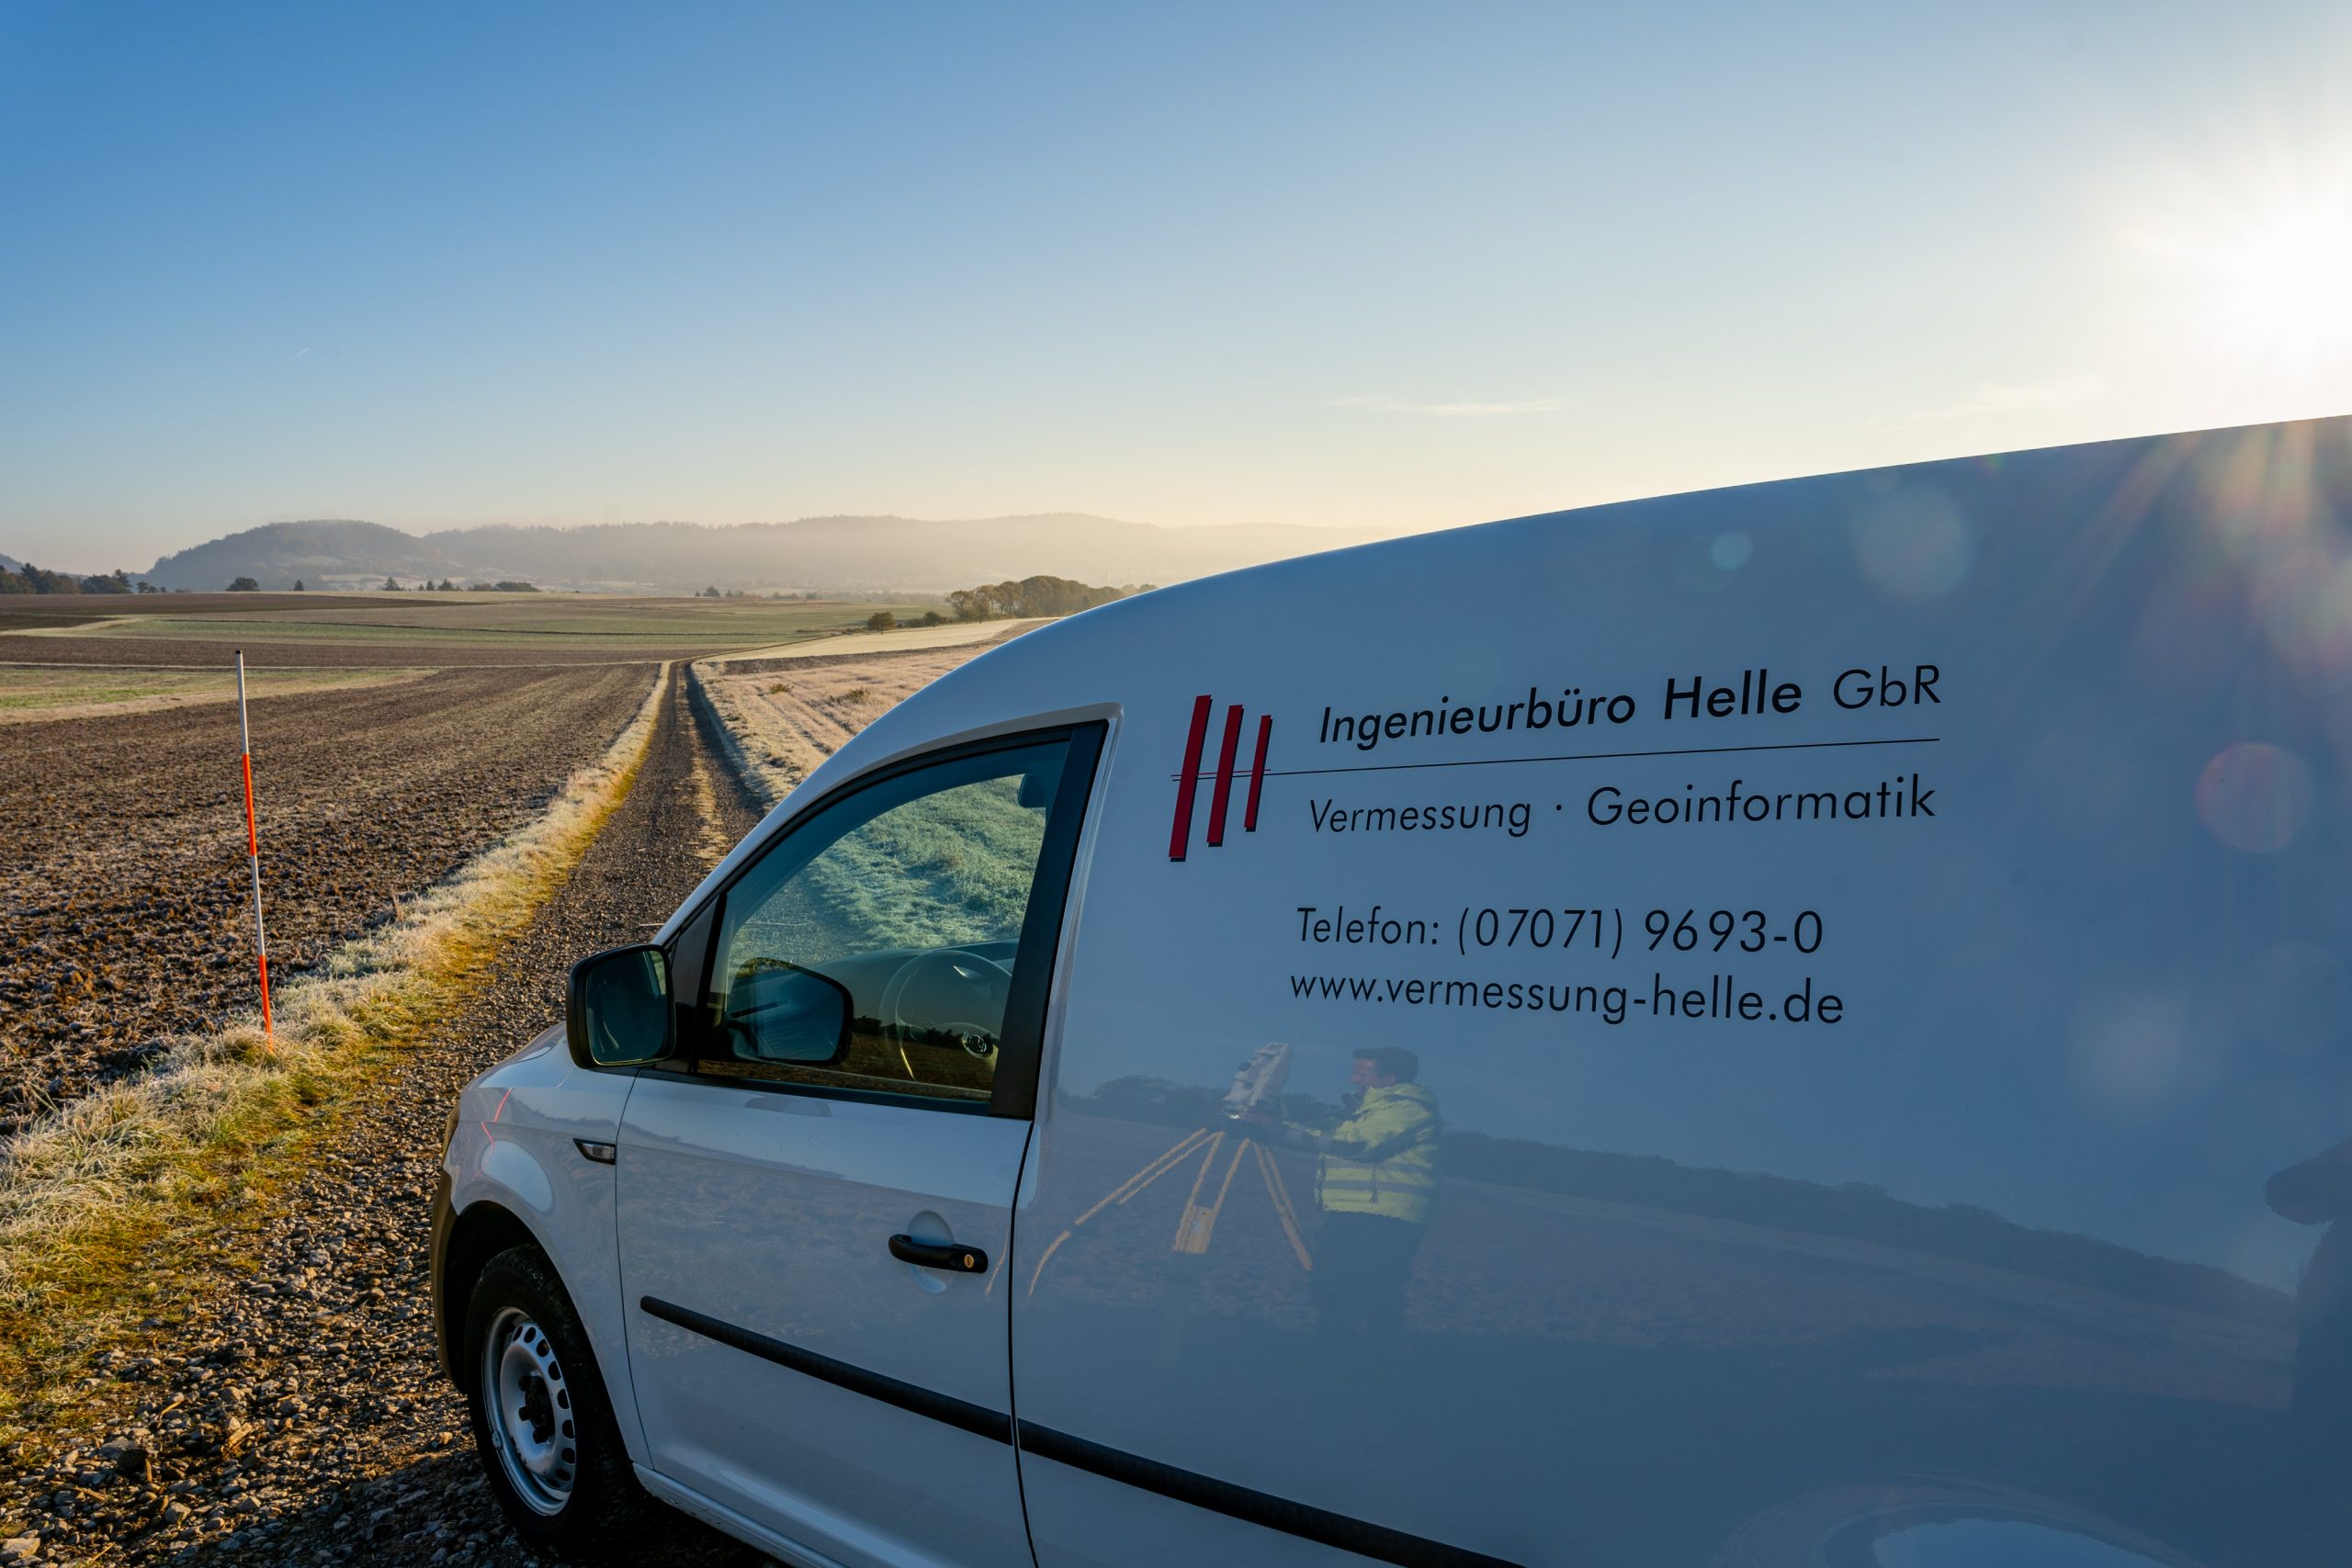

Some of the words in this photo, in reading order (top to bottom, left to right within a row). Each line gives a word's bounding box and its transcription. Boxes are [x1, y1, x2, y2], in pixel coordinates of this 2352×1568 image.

[1319, 687, 1636, 751] Ingenieurbüro
[1664, 668, 1803, 720] Helle
[1833, 664, 1941, 710] GbR
[1309, 798, 1532, 838] Vermessung
[1587, 773, 1936, 826] Geoinformatik
[1296, 905, 1439, 946] Telefon:
[1458, 907, 1623, 961] (07071)
[1645, 909, 1823, 954] 9693-0
[1290, 972, 1844, 1025] www.vermessung-helle.de
